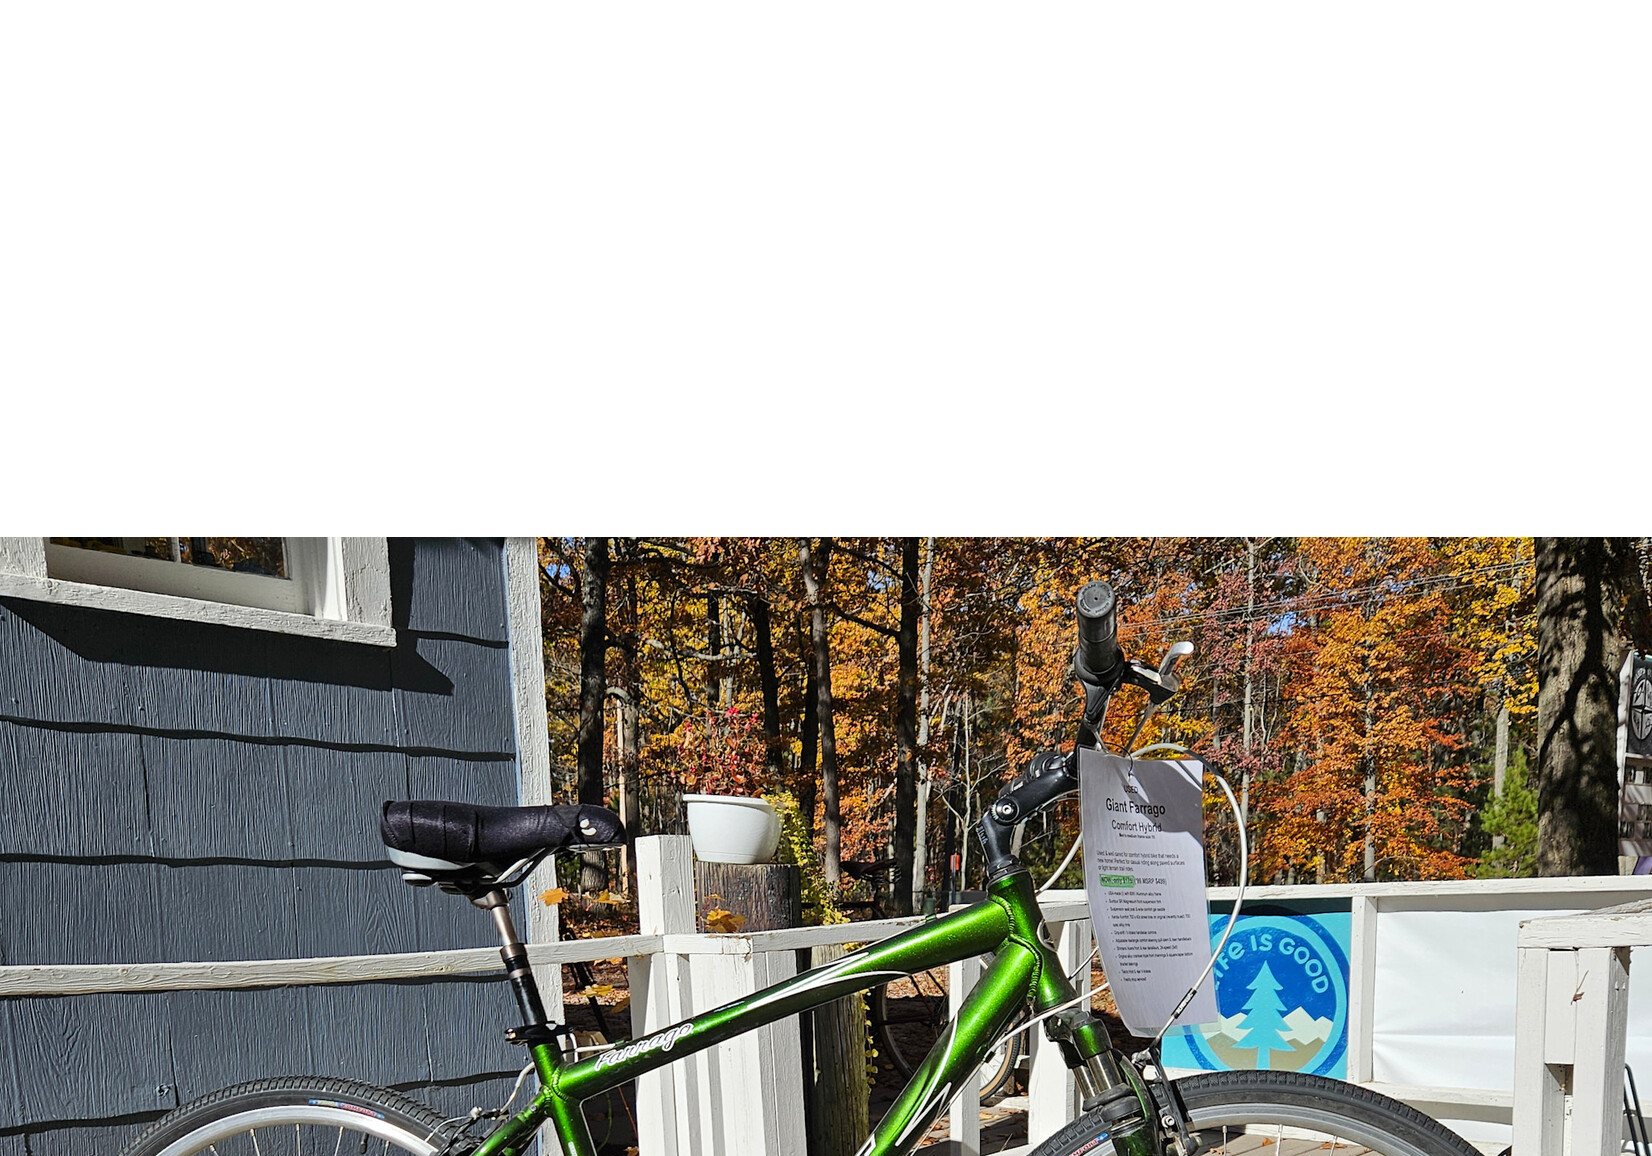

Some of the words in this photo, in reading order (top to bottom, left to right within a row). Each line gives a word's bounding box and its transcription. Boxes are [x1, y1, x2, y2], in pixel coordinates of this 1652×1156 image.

[1124, 785, 1138, 794] USED
[1106, 798, 1128, 813] Giant
[1129, 801, 1166, 818] Farrago
[1112, 820, 1138, 831] Comfort
[1139, 822, 1162, 834] Hybrid
[1250, 933, 1273, 952] IS
[1278, 936, 1329, 994] GOOD
[594, 1022, 695, 1072] Farrago
